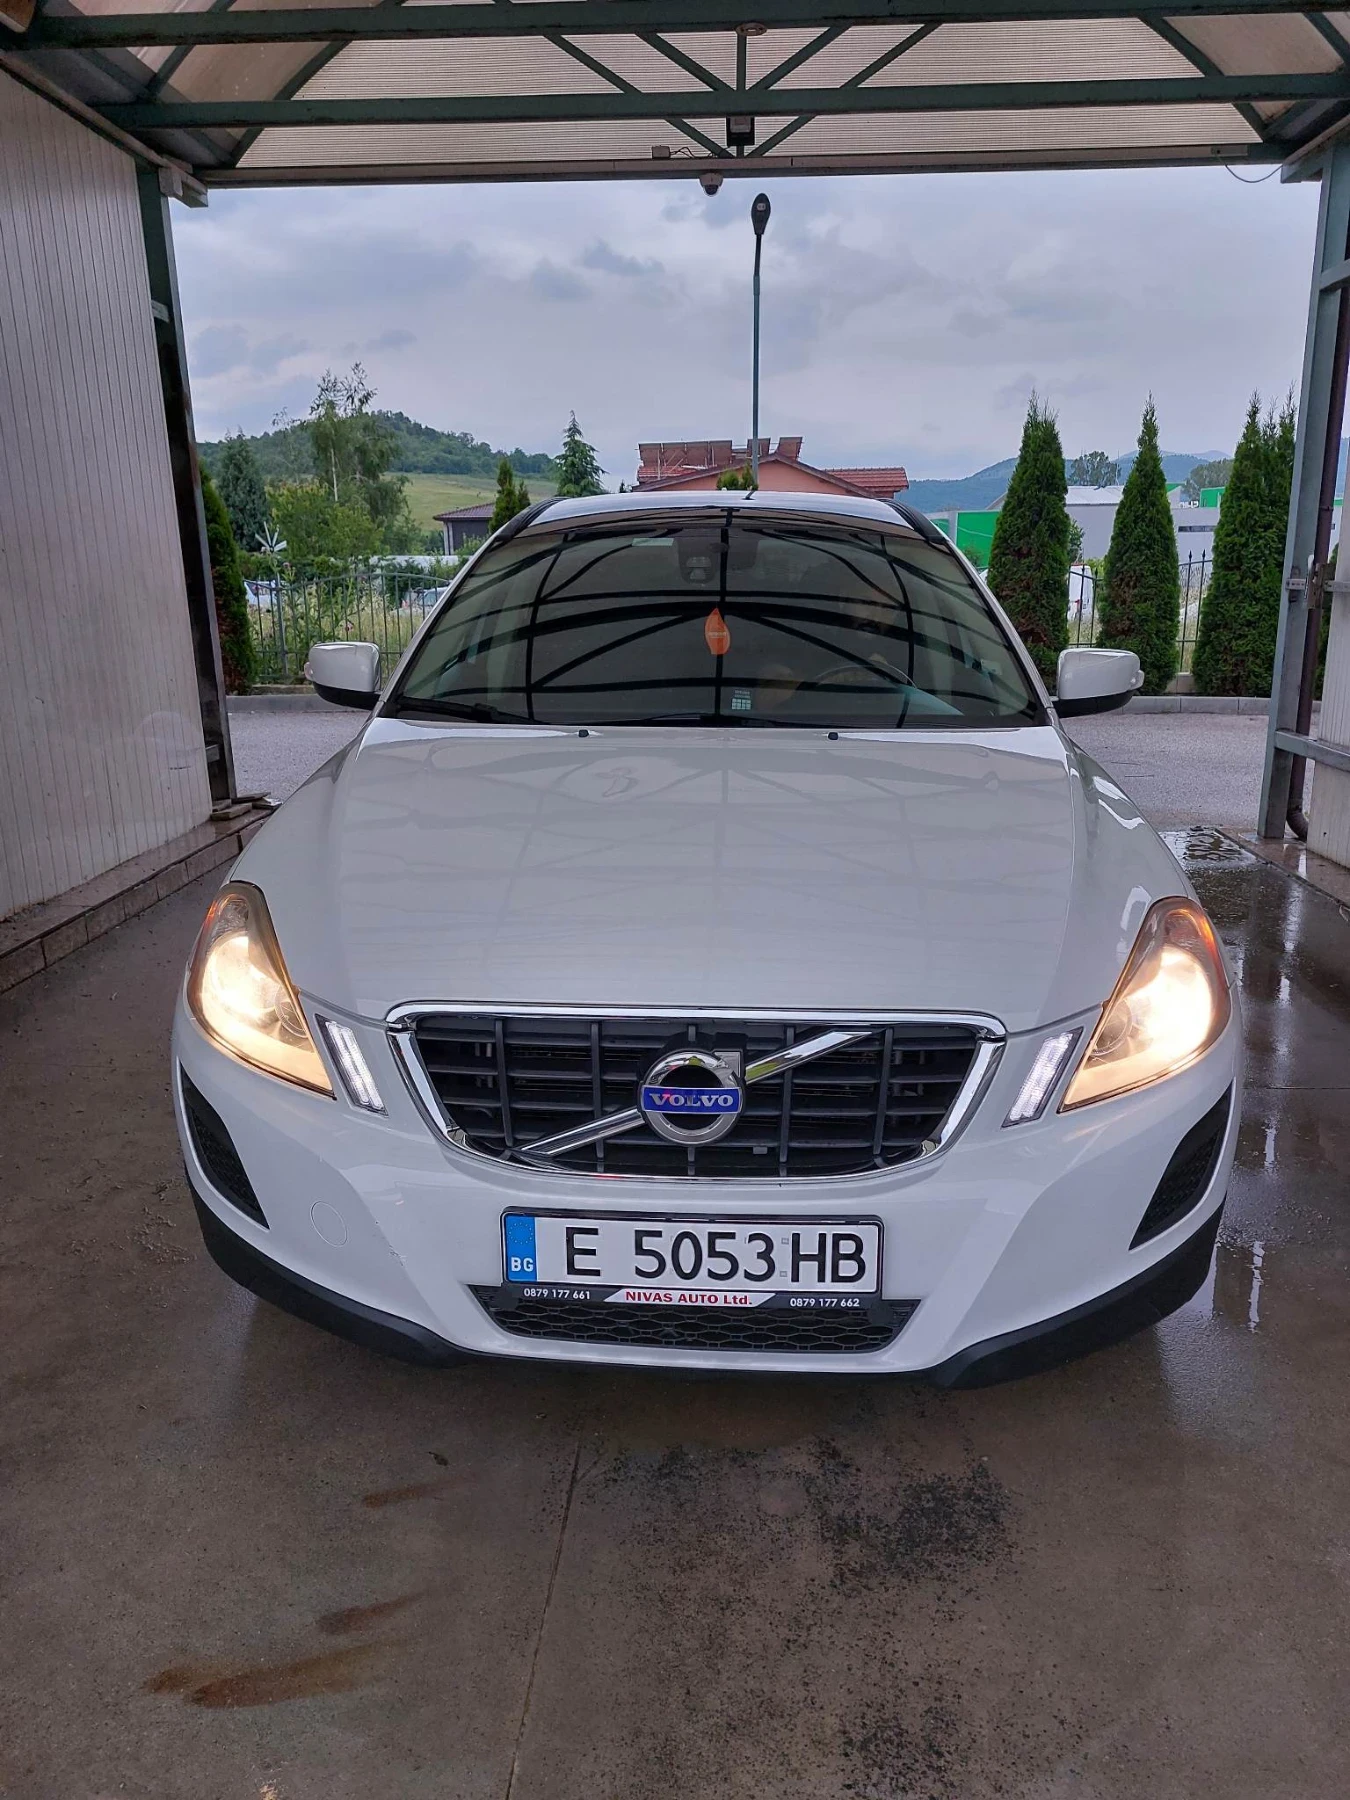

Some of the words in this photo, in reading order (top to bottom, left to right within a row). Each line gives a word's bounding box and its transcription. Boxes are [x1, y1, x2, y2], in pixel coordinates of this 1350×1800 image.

[649, 1093, 734, 1107] VOLVO
[565, 1226, 601, 1277] E
[634, 1229, 776, 1281] 5053
[791, 1232, 866, 1283] HB
[511, 1257, 534, 1272] BG
[524, 1288, 548, 1298] 0879
[552, 1289, 570, 1299] 177
[573, 1290, 590, 1300] 661
[625, 1291, 673, 1303] NIVAS
[678, 1293, 719, 1304] AUTO
[723, 1294, 753, 1305] Ltd.
[790, 1298, 815, 1307] 0879
[819, 1298, 838, 1307] 177
[840, 1298, 860, 1308] 662
